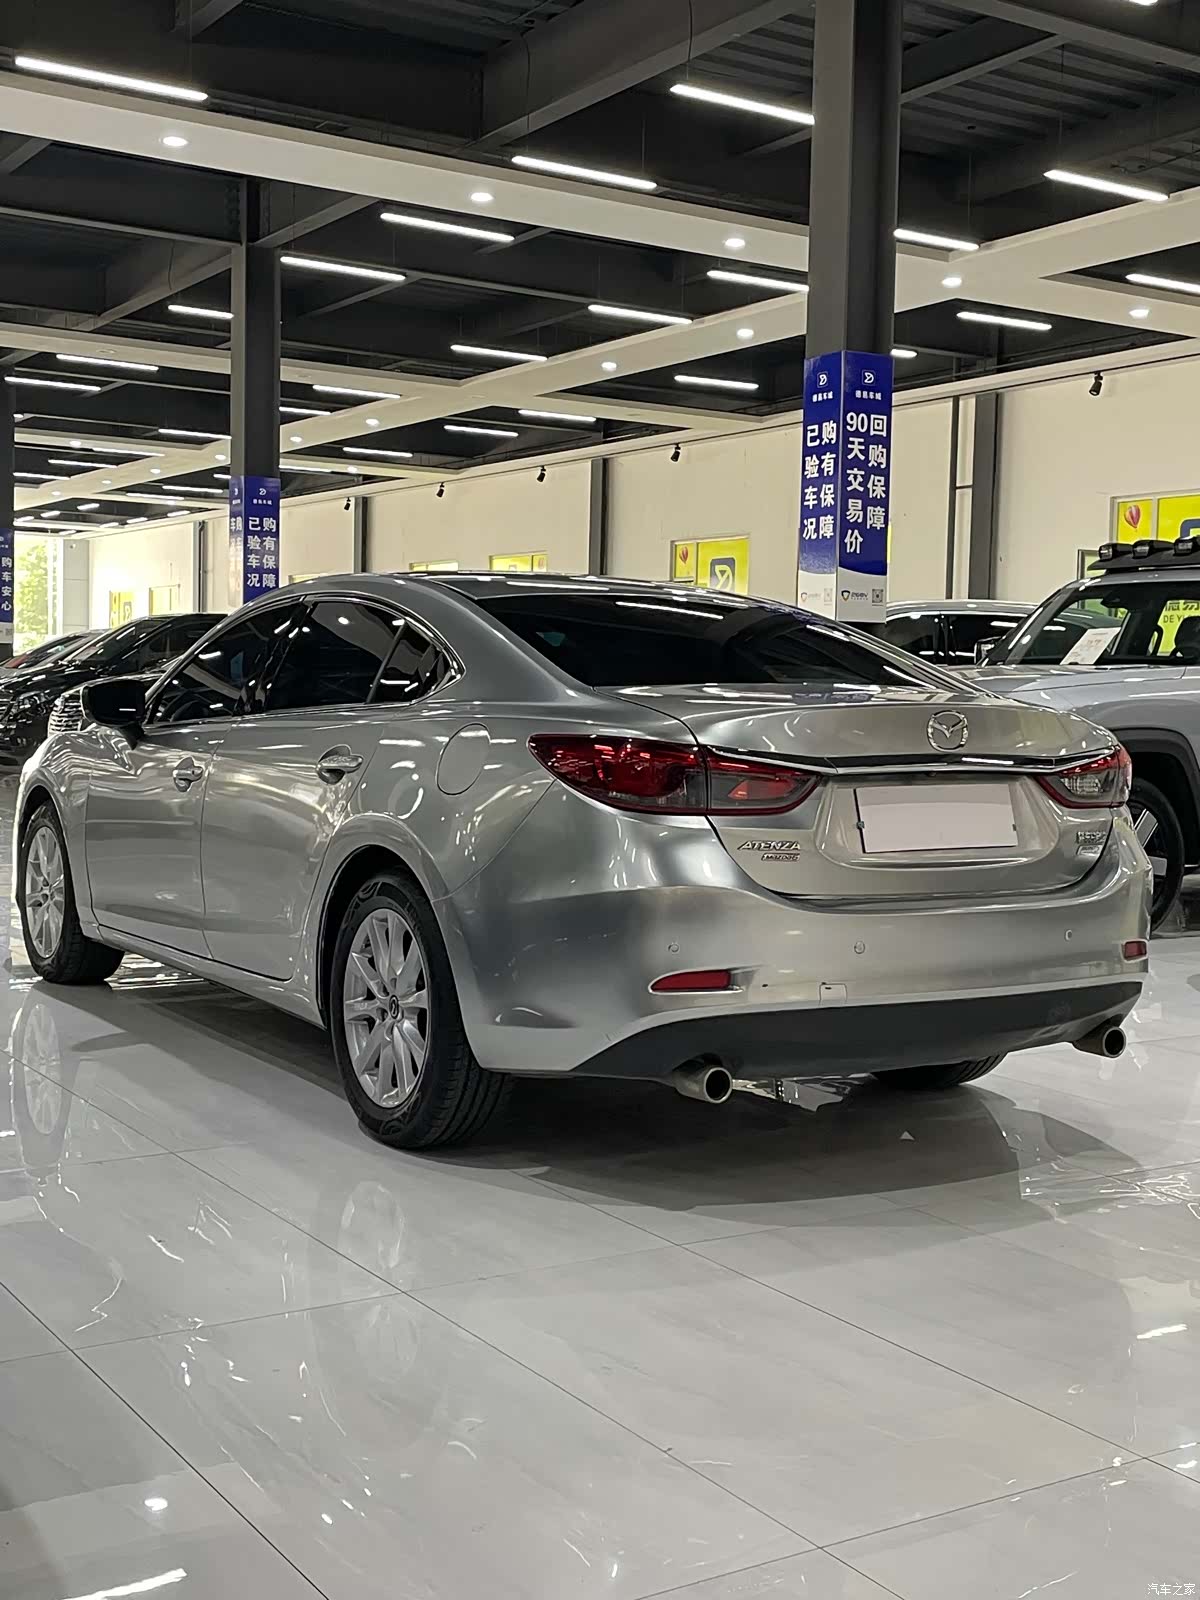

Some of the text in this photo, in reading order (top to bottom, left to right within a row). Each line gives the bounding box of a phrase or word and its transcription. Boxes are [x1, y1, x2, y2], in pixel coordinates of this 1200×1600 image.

[803, 424, 820, 540] 已验车况
[819, 420, 837, 540] 购有保障
[844, 412, 869, 554] 90天交易价
[867, 414, 887, 530] 回购保障
[1, 556, 12, 611] 购车安心
[247, 517, 261, 587] 已验车况
[262, 517, 277, 588] 购有保障
[738, 840, 801, 850] ATENZA
